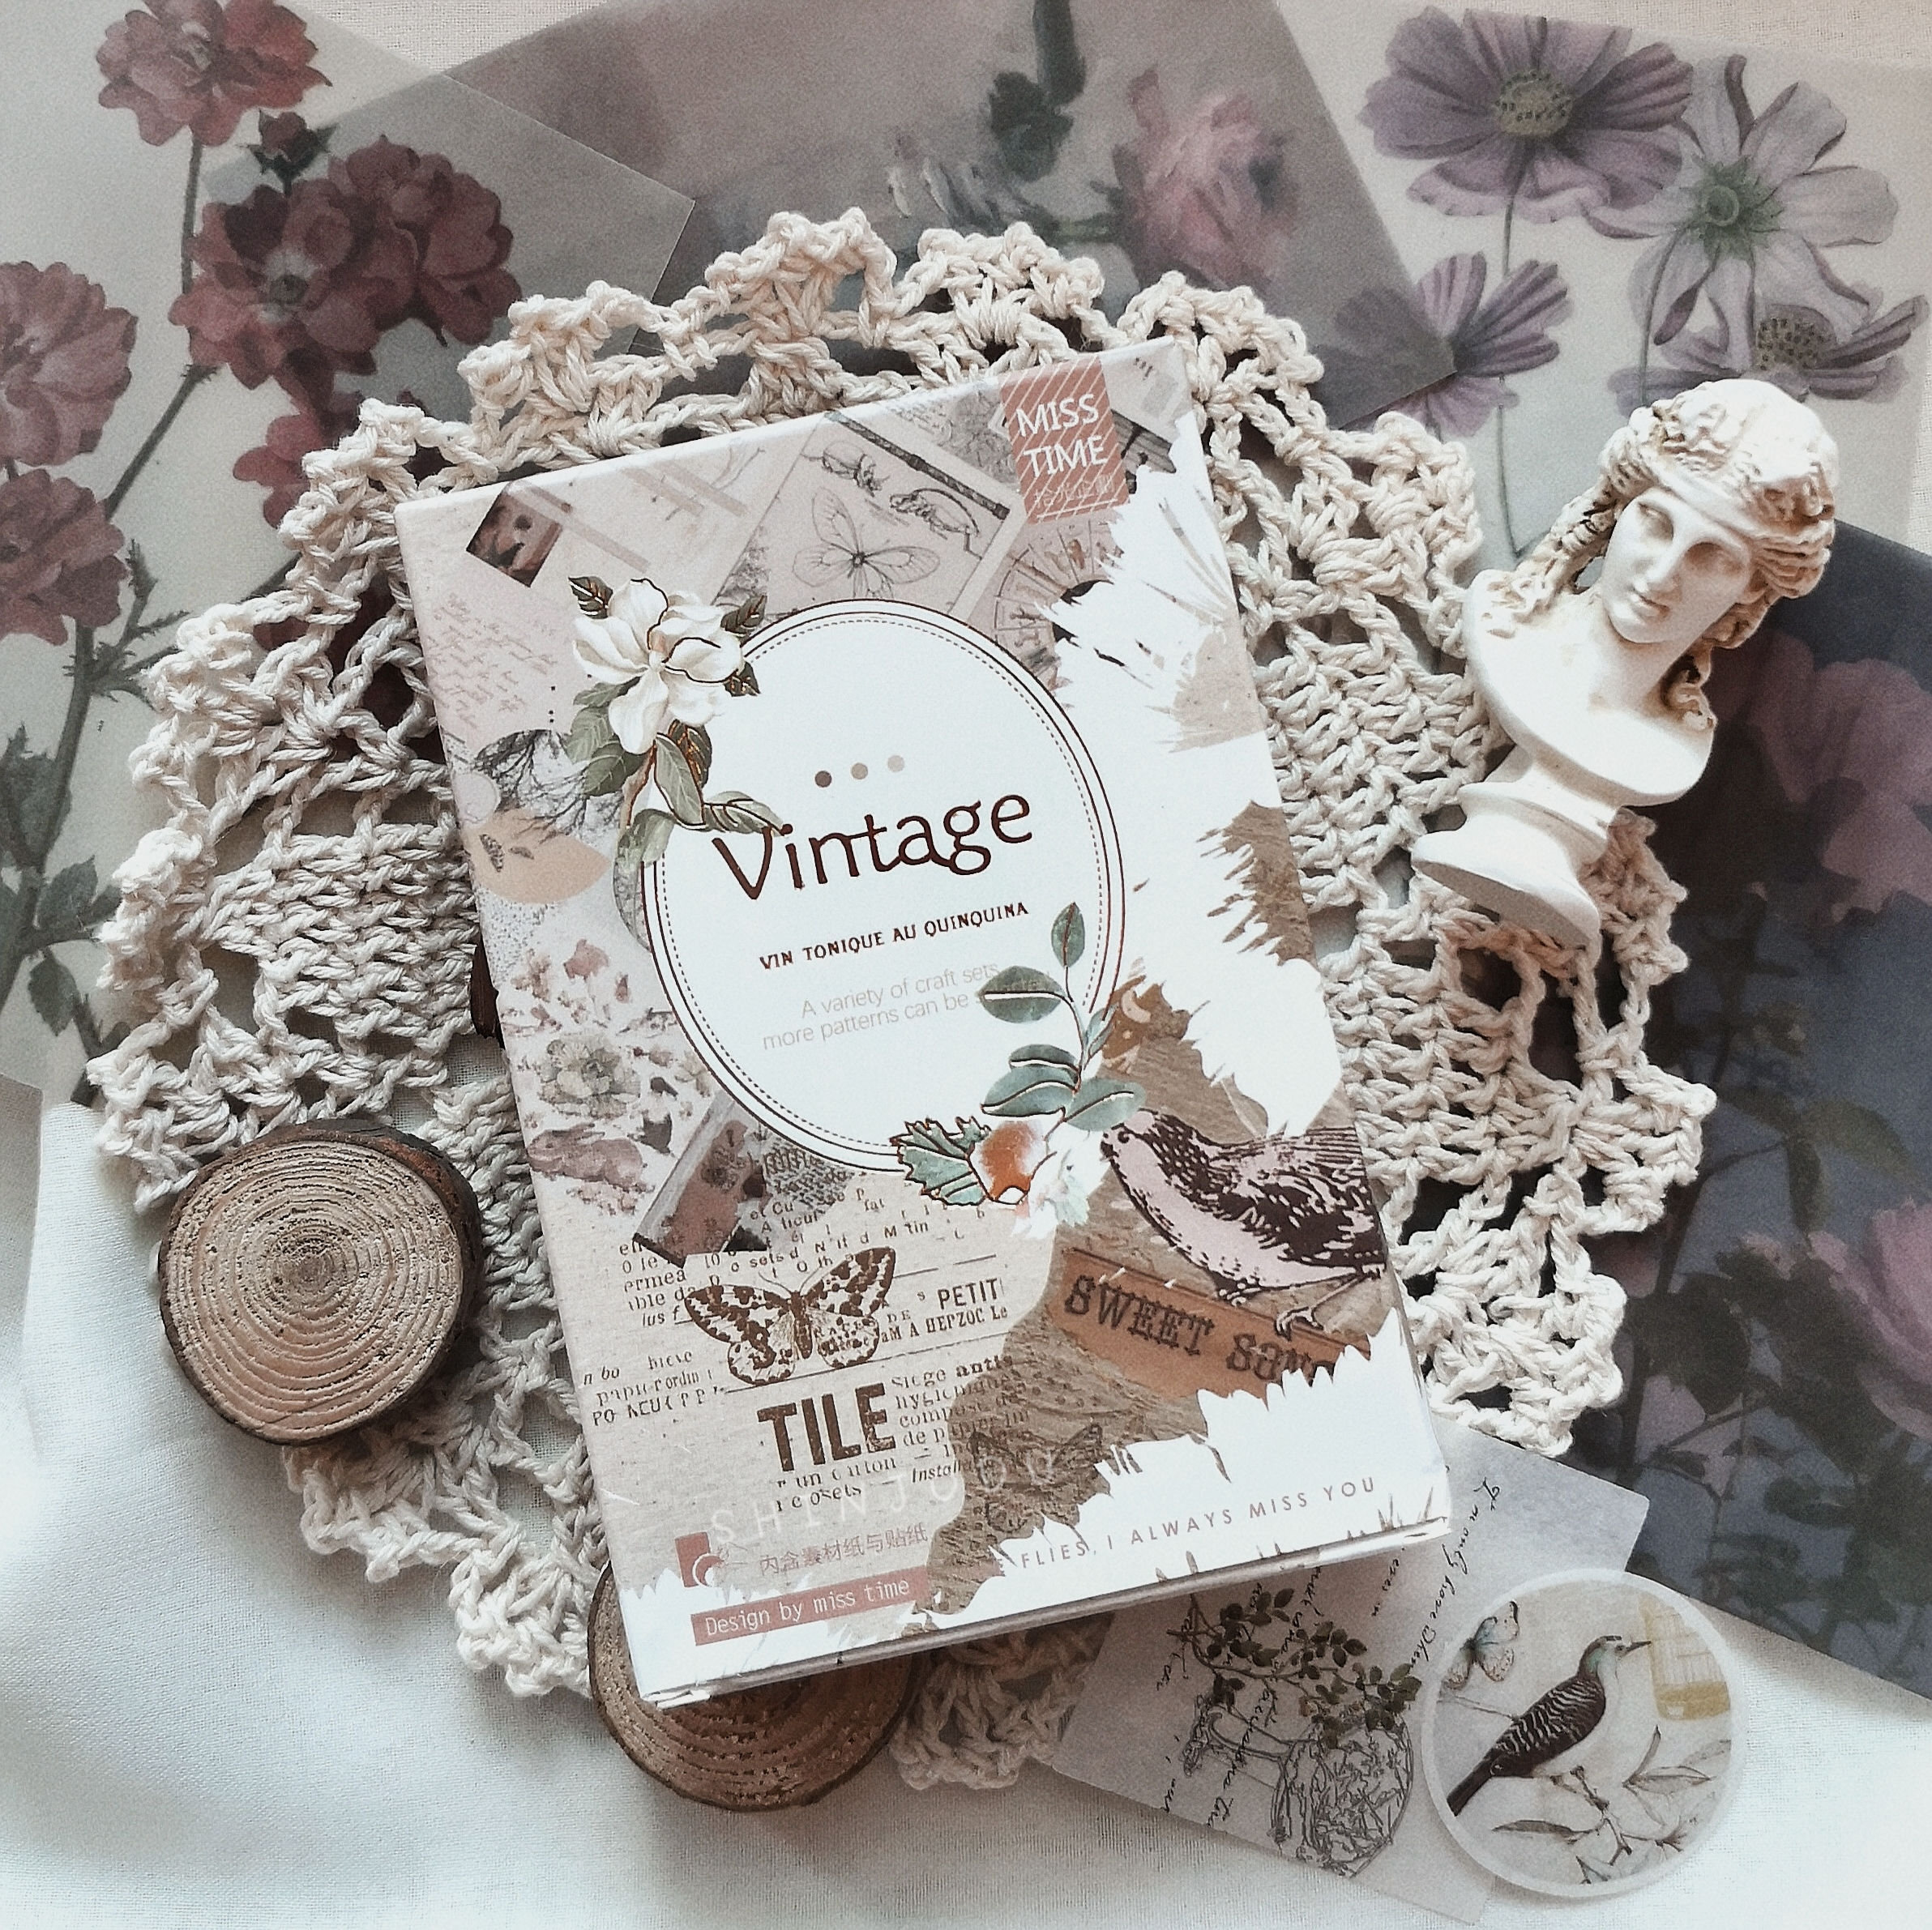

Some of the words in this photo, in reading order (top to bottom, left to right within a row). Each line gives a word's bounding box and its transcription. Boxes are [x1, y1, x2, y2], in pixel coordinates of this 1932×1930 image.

[1015, 393, 1099, 438] MISS
[1023, 435, 1108, 477] TIME
[712, 794, 1032, 900] Vintage
[759, 950, 793, 971] VIN
[801, 931, 884, 961] TONIQUE
[891, 924, 917, 942] AU
[923, 901, 1029, 937] QUINQUINA
[762, 1027, 814, 1051] more
[819, 1008, 900, 1040] patterns
[904, 1000, 939, 1019] can
[944, 988, 969, 1010] be
[801, 1000, 816, 1019] A
[820, 986, 885, 1016] variety
[890, 976, 909, 1000] of
[915, 969, 958, 996] craft
[962, 962, 999, 984] sets
[937, 1277, 998, 1311] PETIT
[1065, 1275, 1215, 1356] SWEET
[756, 1381, 896, 1472] TILE
[1107, 1534, 1113, 1550] I
[1131, 1509, 1233, 1544] ALWAYS
[1249, 1492, 1308, 1518] MISS
[1323, 1478, 1376, 1501] YOU
[761, 1524, 928, 1576] 内含素材纸与贴纸
[704, 1607, 771, 1637] Design
[779, 1603, 802, 1623] by
[813, 1589, 857, 1614] miss
[864, 1578, 910, 1604] time
